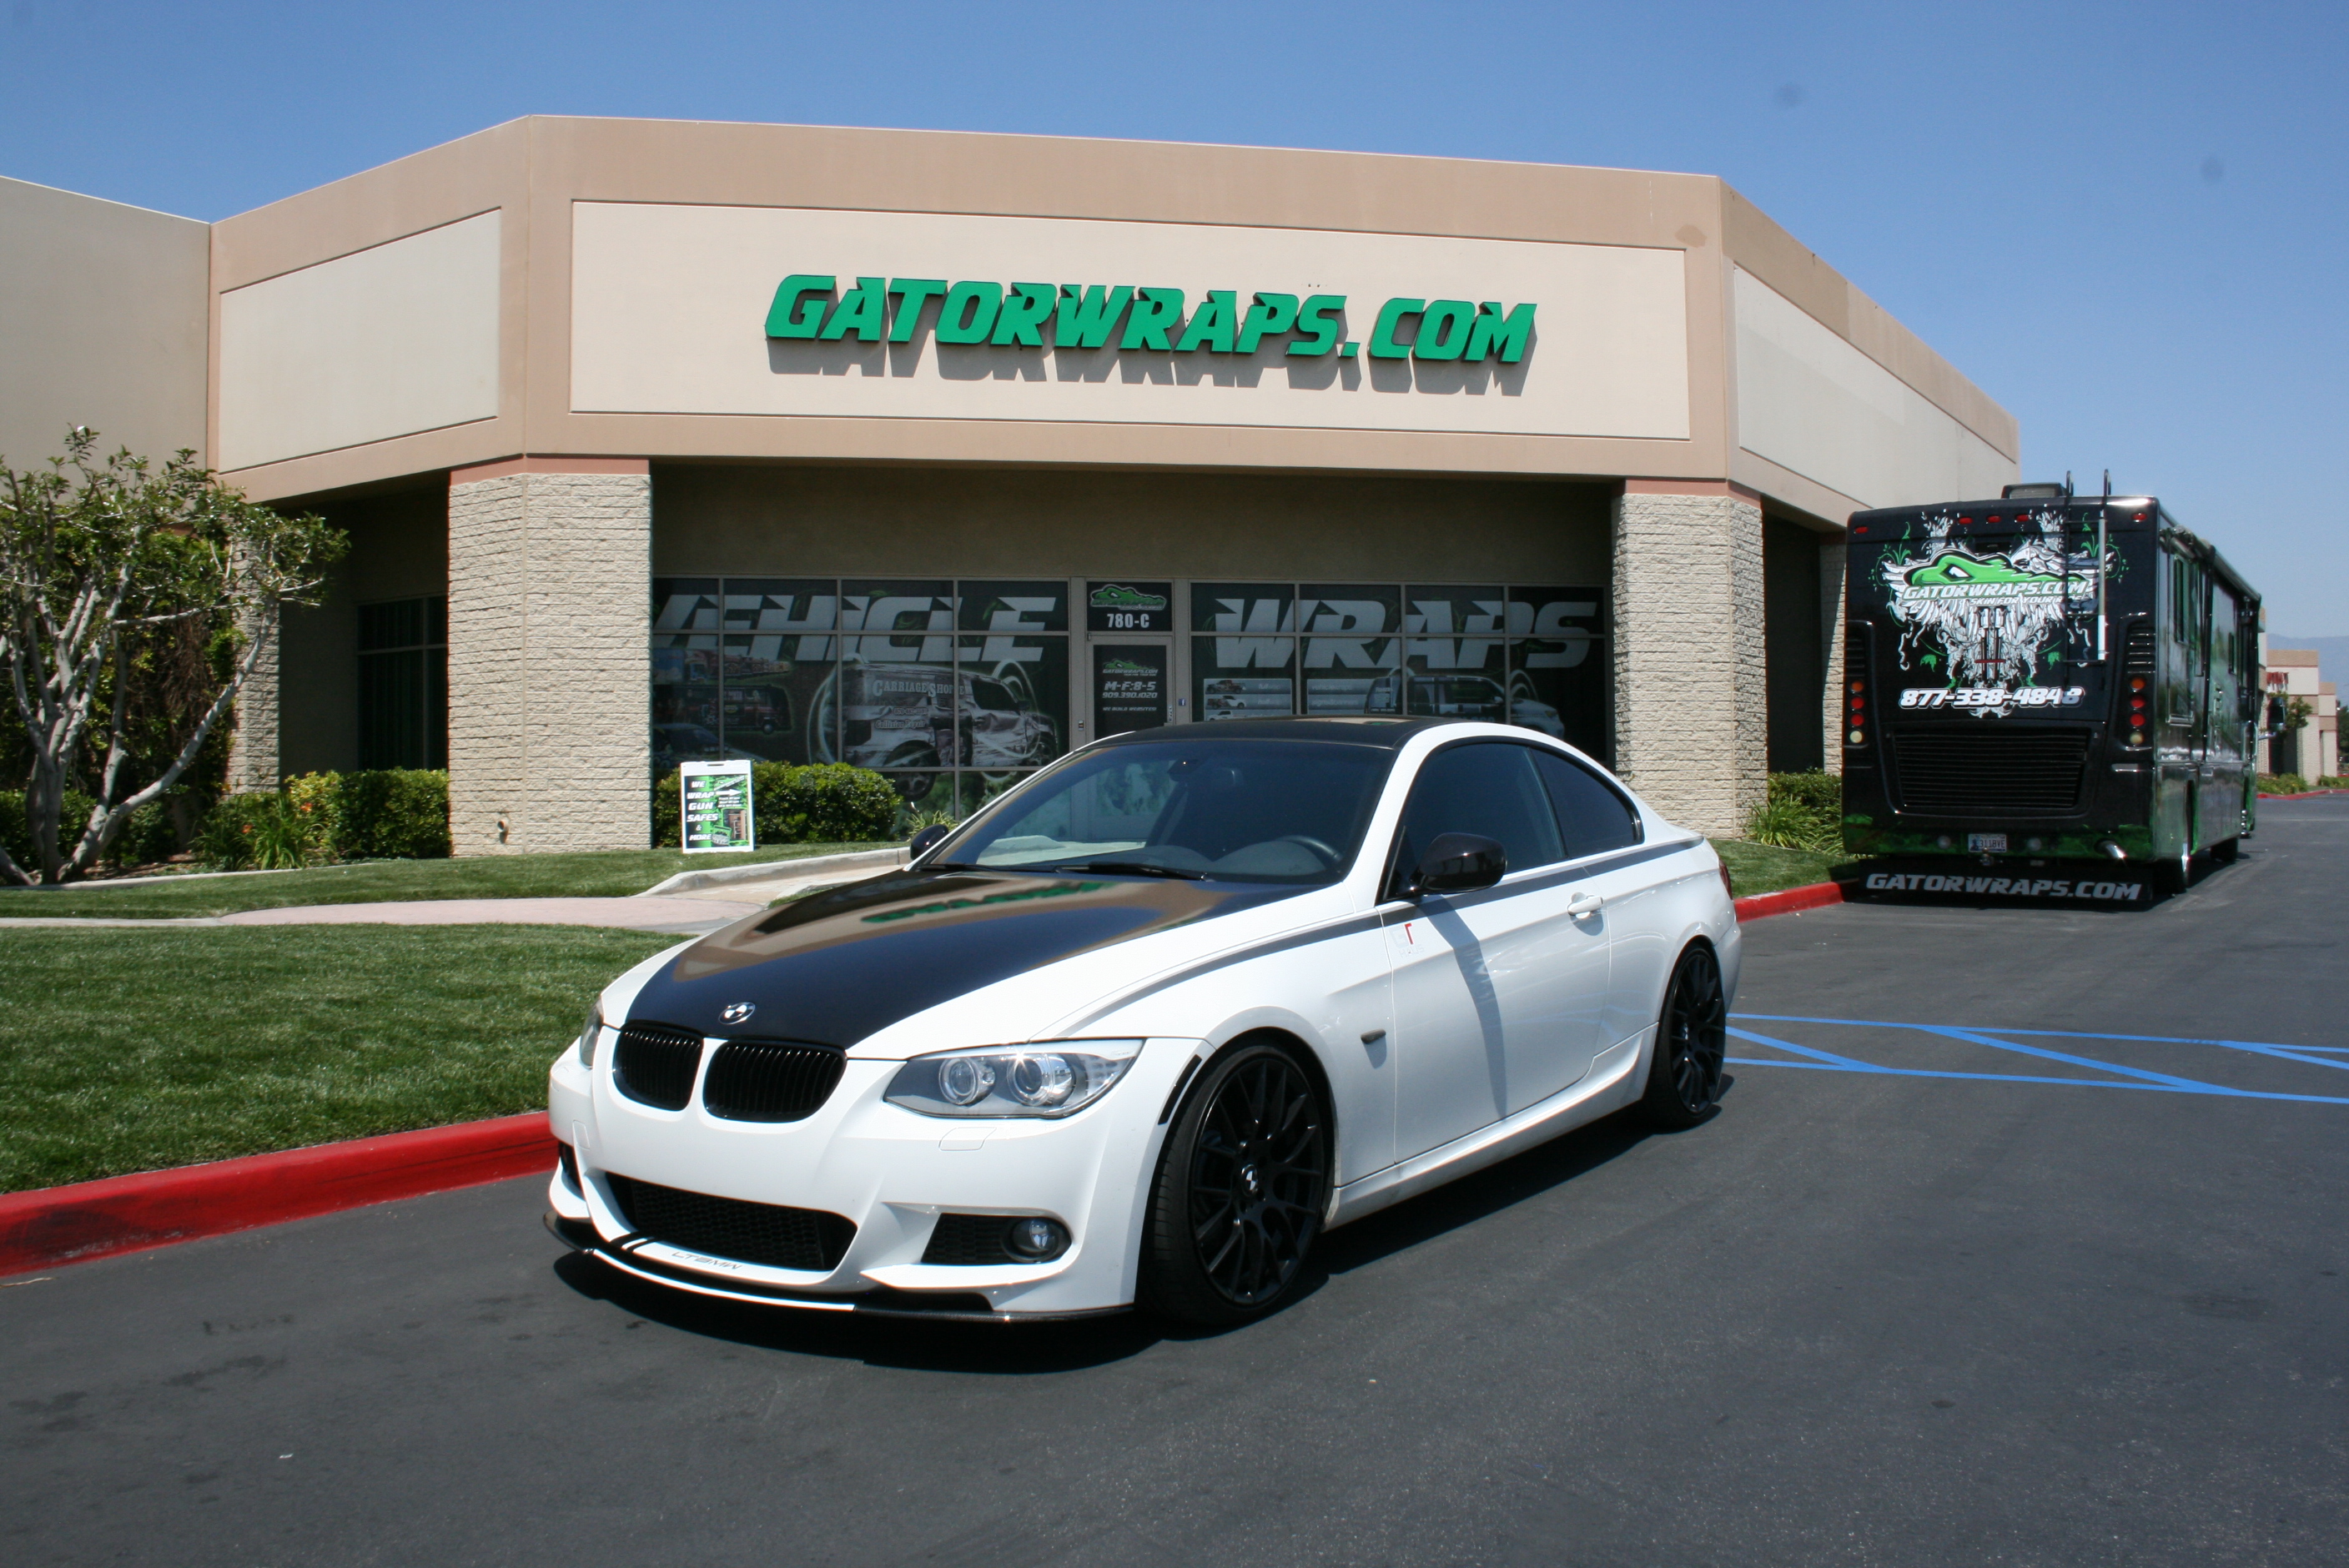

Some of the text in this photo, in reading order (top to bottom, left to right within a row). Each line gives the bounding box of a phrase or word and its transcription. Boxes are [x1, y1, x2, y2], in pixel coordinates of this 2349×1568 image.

[765, 274, 1537, 364] GATORWRAPS.COM
[1903, 580, 2087, 600] GATORWRAPS.COM
[1970, 597, 1996, 606] SKIN
[1997, 596, 2020, 605] FOR
[2023, 596, 2053, 604] YOUR
[1107, 613, 1149, 628] 780-C
[1215, 598, 1597, 668] WRAPS
[872, 679, 964, 697] CARRIAGE SHOPE
[1900, 686, 2085, 707] 877-338-4848
[688, 802, 714, 811] GUN
[687, 813, 719, 822] SAFES
[1866, 873, 2142, 900] GATORWRAPS.COM
